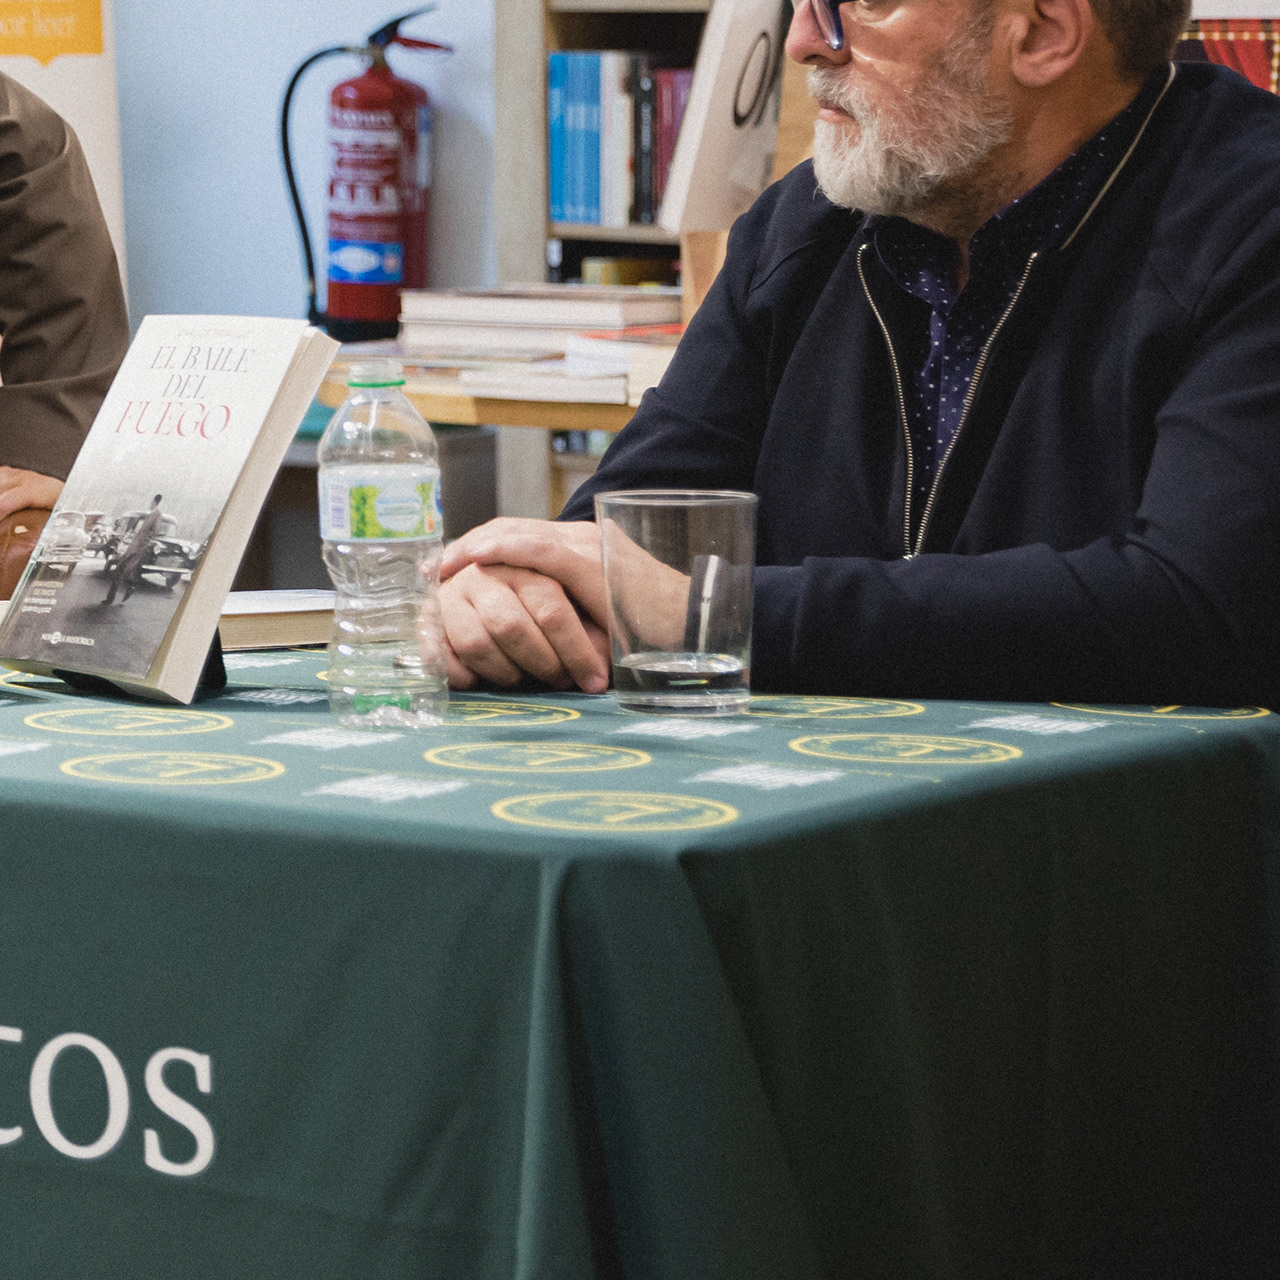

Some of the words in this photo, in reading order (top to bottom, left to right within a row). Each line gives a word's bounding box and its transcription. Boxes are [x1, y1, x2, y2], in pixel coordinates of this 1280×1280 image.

[32, 8, 77, 38] leer
[150, 346, 177, 370] EL
[161, 373, 207, 400] DEL
[115, 400, 231, 440] FUEGO
